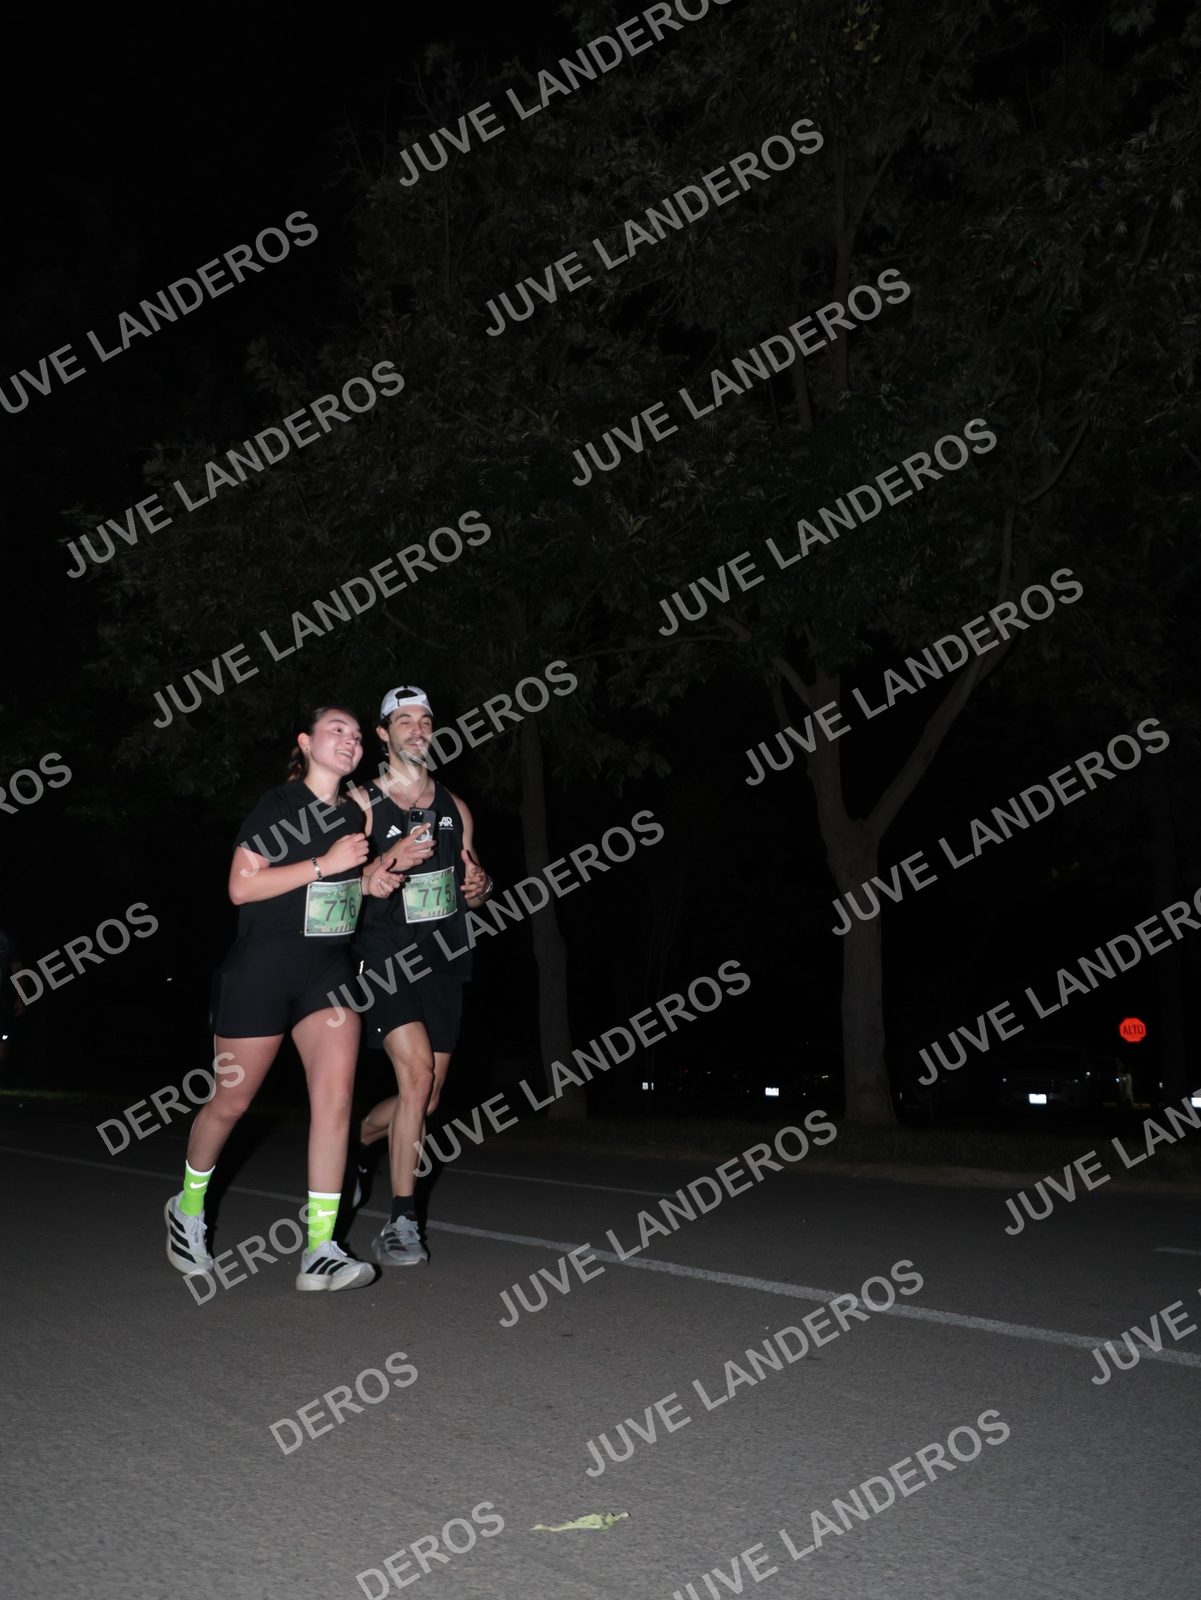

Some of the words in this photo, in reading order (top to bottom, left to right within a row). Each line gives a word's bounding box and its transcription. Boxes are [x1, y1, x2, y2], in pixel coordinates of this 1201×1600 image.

[418, 884, 452, 908] 775
[324, 897, 356, 922] 776
[1123, 1024, 1144, 1035] ALTO
